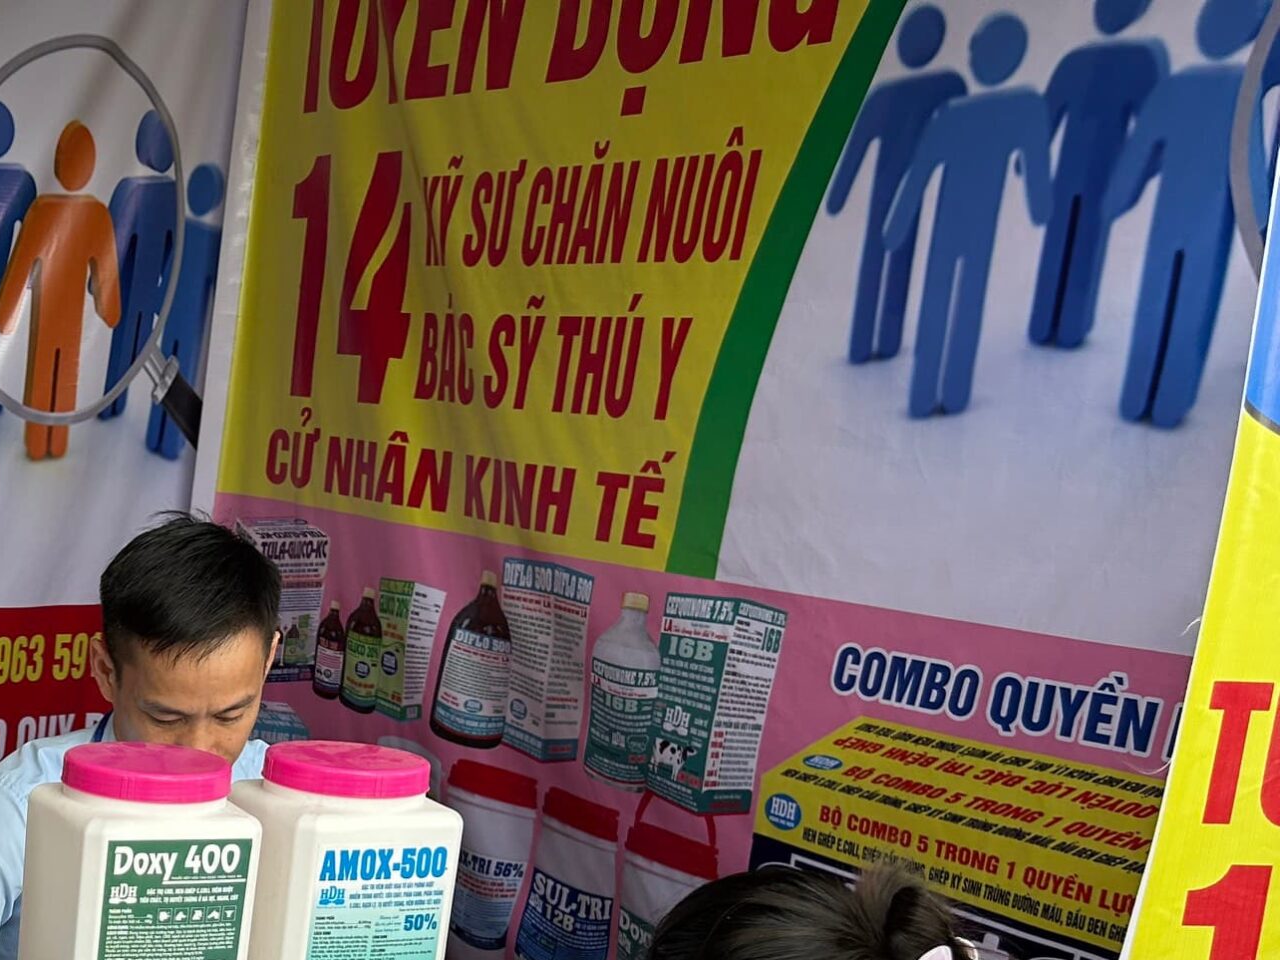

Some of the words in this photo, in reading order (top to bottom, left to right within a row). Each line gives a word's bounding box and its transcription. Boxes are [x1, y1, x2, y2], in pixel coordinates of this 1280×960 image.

[423, 155, 465, 268] KỸ
[462, 160, 527, 268] SƯ
[521, 141, 640, 266] CHĂN
[637, 126, 763, 264] NUÔI
[291, 150, 412, 405] 14
[414, 292, 476, 402] BÁC
[482, 296, 549, 411] SỸ
[550, 293, 648, 418] THÚ
[654, 316, 693, 421] Y
[265, 407, 322, 487] CỬ
[323, 430, 453, 513] NHÂN
[463, 455, 576, 536] KINH
[595, 451, 677, 550] TẾ
[455, 628, 489, 649] DIFLO
[668, 636, 714, 661] 16B
[833, 646, 980, 717] COMBO
[990, 673, 1160, 754] QUYỀN
[770, 798, 796, 822] HDH
[113, 846, 178, 881] Doxy
[185, 844, 241, 874] 400
[319, 846, 448, 881] AMOX-500
[494, 858, 524, 878] 56%
[819, 805, 842, 829] BỘ
[847, 814, 911, 847] COMBO
[917, 836, 928, 853] 5
[936, 839, 998, 875] TRONG
[1007, 861, 1016, 878] 1
[1023, 866, 1093, 905] QUYỀN
[320, 885, 345, 900] HDH
[533, 872, 613, 921] SUL-TRI
[404, 913, 437, 931] 50%
[544, 903, 574, 932] 12B
